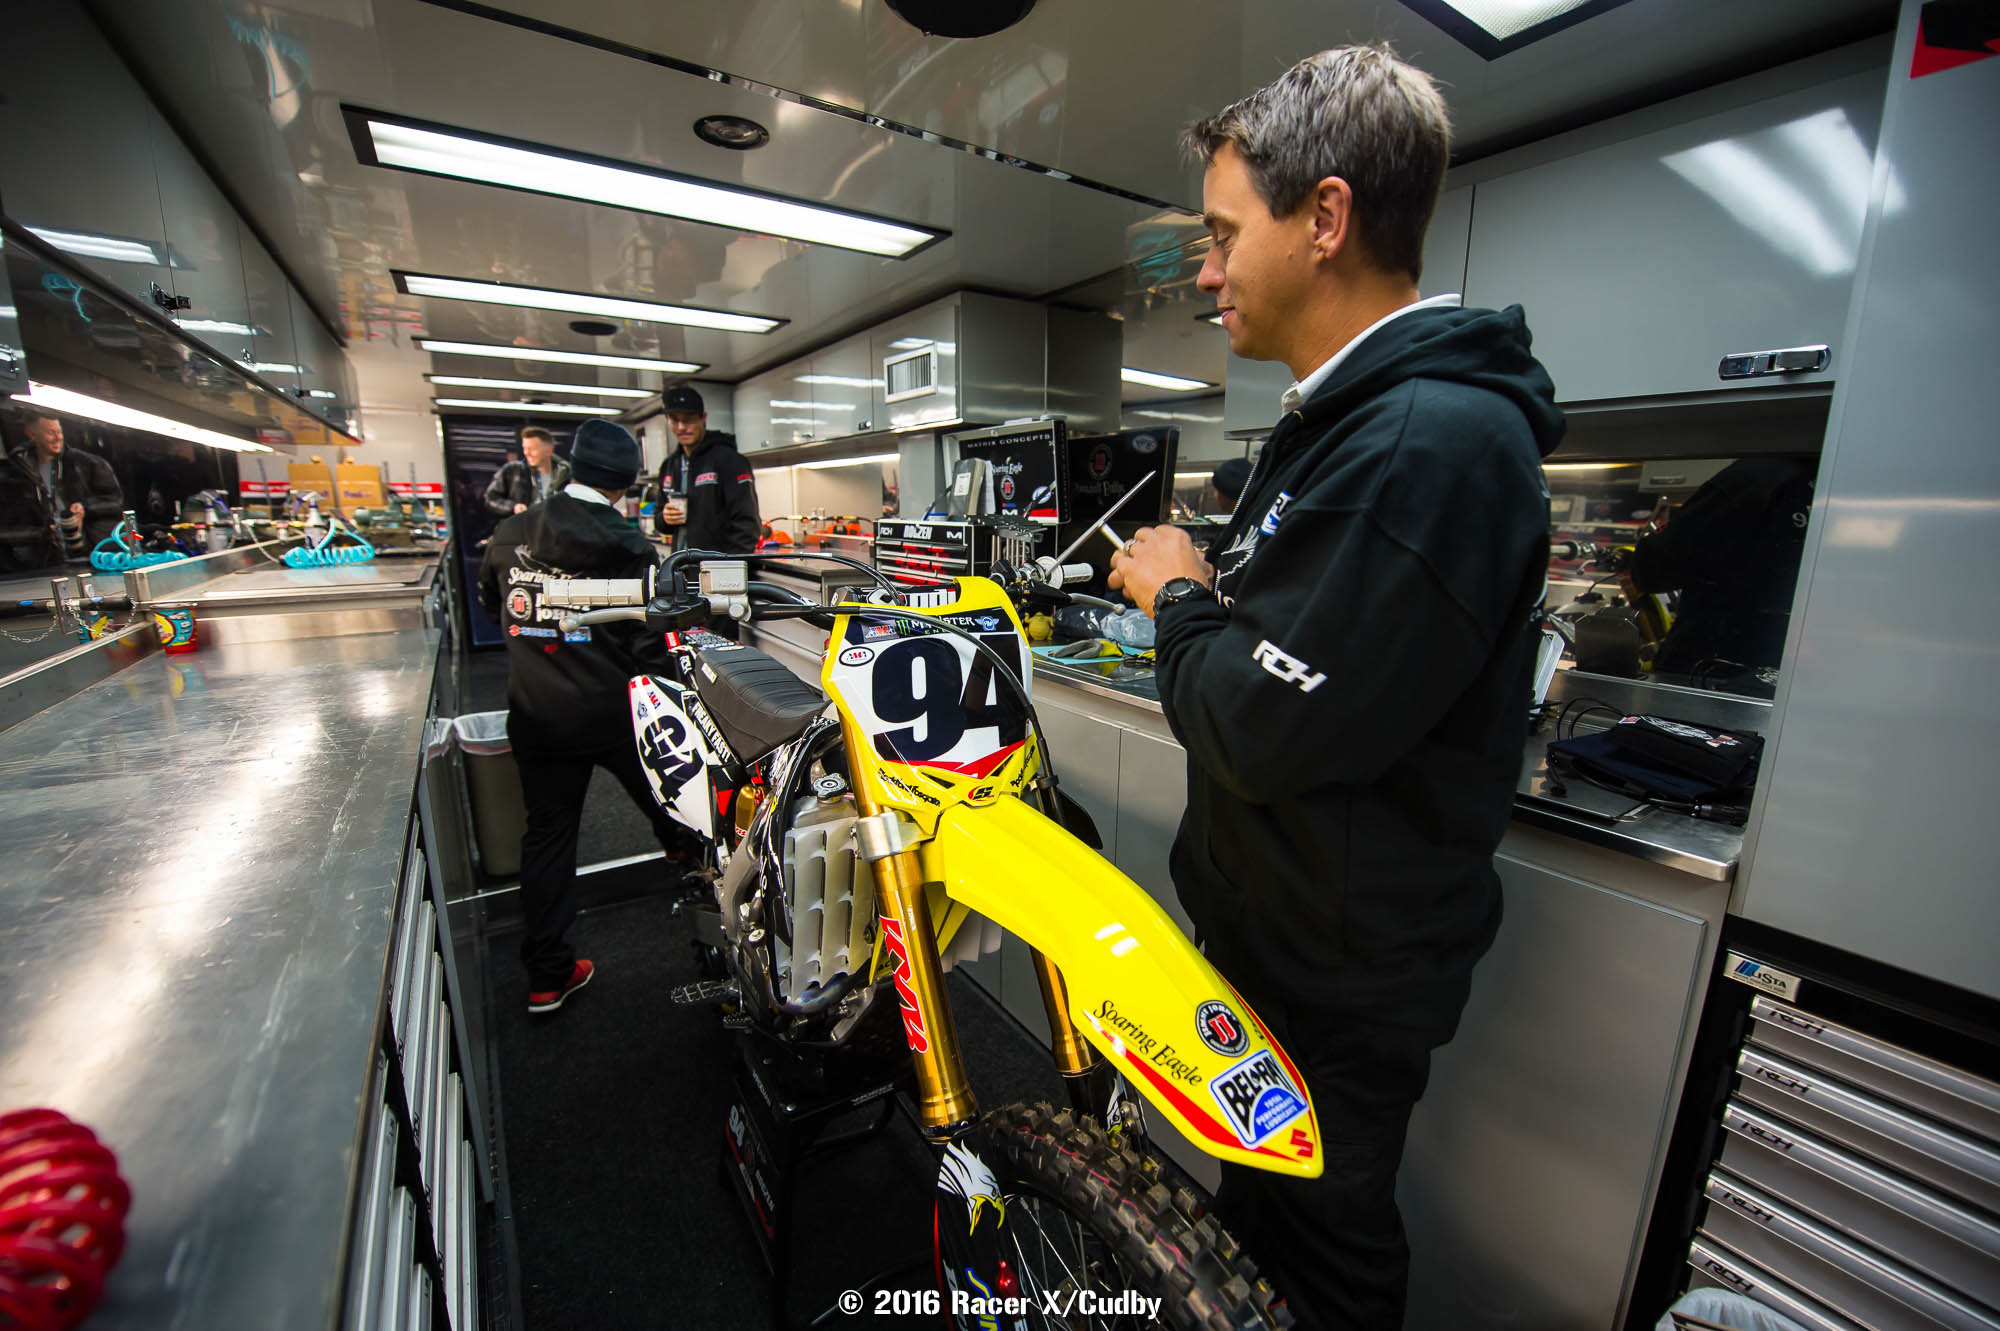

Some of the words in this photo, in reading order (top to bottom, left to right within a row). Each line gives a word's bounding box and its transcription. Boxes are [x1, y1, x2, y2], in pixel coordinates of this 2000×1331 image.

[999, 433, 1051, 445] CONCEPTS
[847, 652, 868, 662] AMA
[1252, 639, 1328, 692] RCH
[872, 637, 1026, 762] 94
[691, 701, 714, 738] FREAKY
[1769, 1007, 1826, 1034] RCH
[1093, 1000, 1157, 1055] Soaring
[1152, 1044, 1203, 1087] Eagle
[1756, 1066, 1811, 1094] RCH
[1741, 1120, 1795, 1150] RCH
[1723, 1191, 1774, 1222] RCH
[1705, 1259, 1755, 1291] RCH
